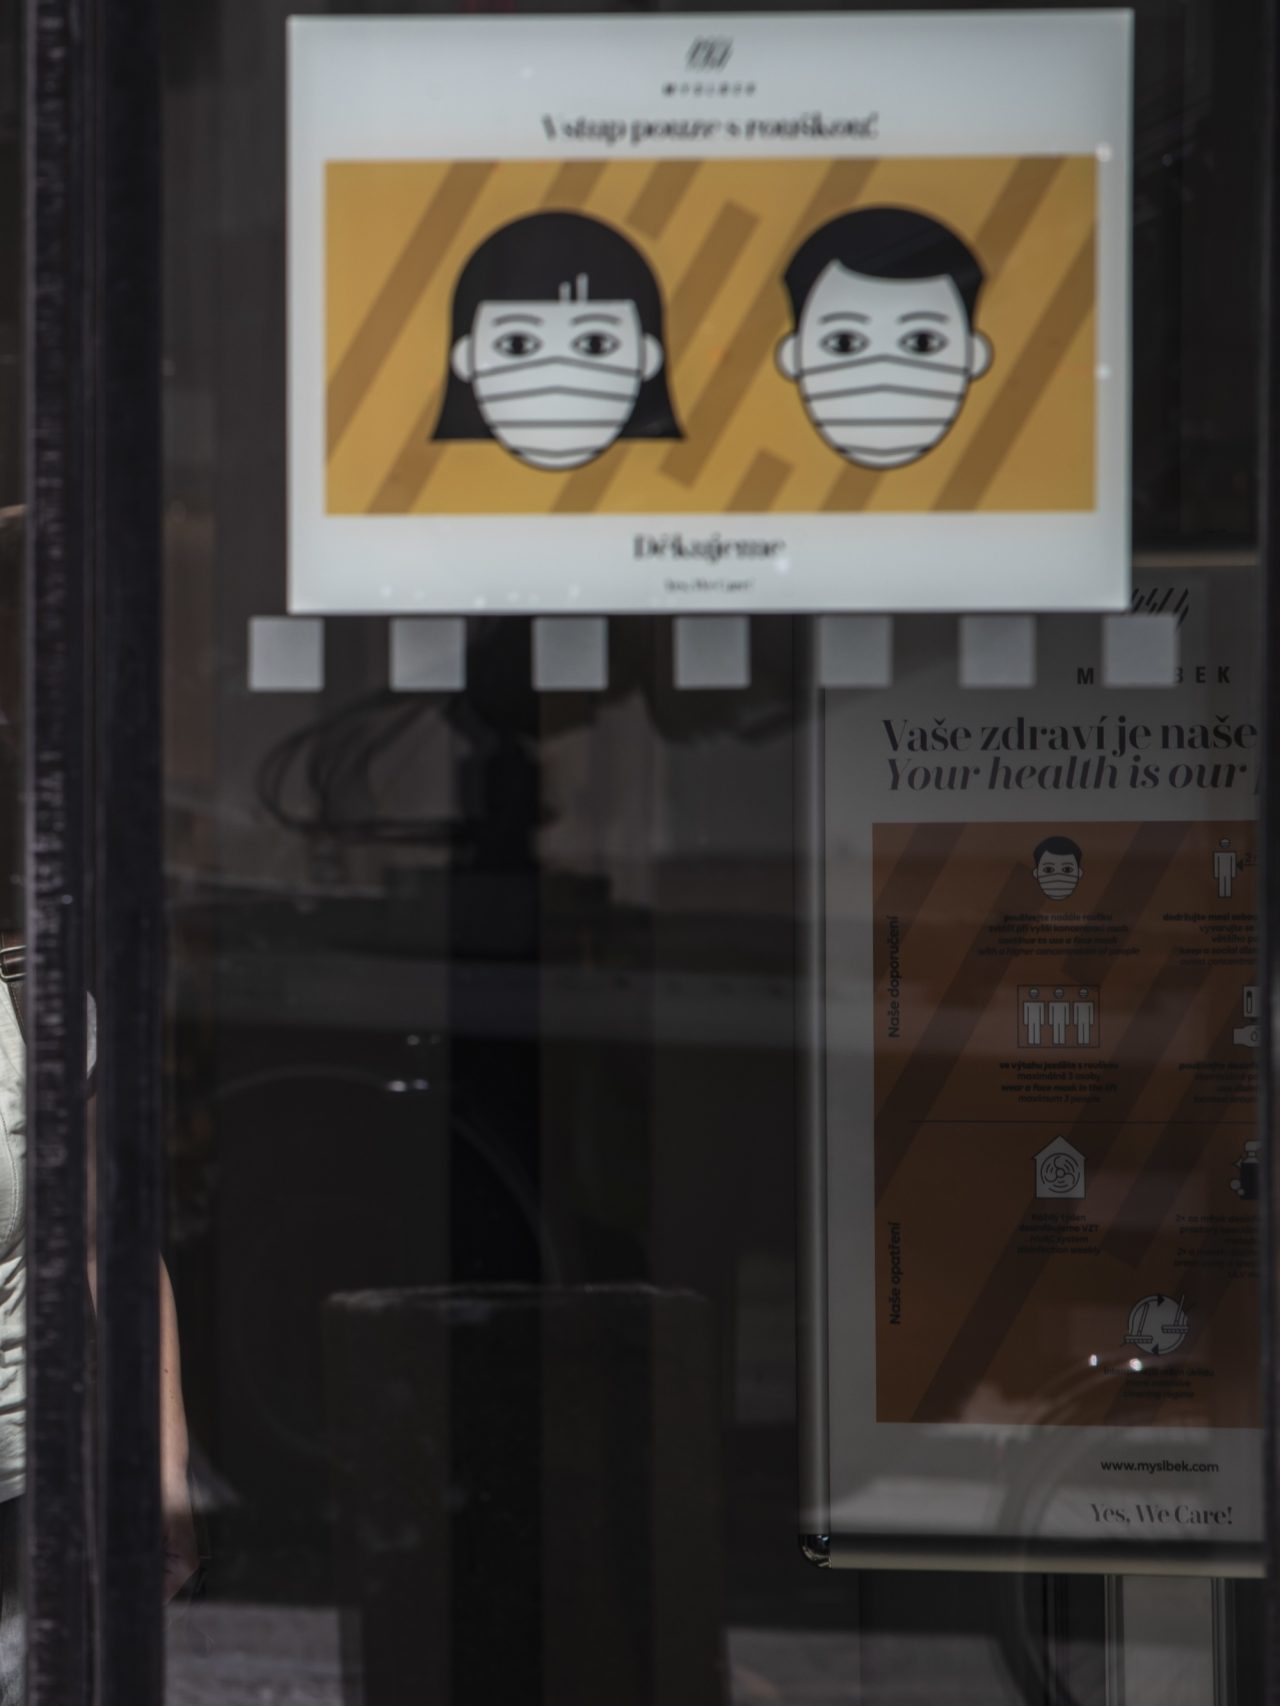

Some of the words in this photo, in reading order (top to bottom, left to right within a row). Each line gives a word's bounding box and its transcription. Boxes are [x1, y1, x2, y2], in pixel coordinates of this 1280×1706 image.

[1077, 666, 1232, 685] MBEK
[882, 717, 972, 752] Vaše
[979, 715, 1108, 751] zdraví
[1112, 715, 1151, 758] je
[1160, 714, 1258, 750] naše
[888, 758, 981, 791] Your
[987, 756, 1118, 790] health
[1129, 754, 1160, 789] is
[1168, 763, 1248, 789] our
[886, 915, 903, 998] doporučení
[888, 1000, 901, 1038] Naše
[888, 1287, 901, 1325] Naše
[1100, 1460, 1220, 1475] www.myslbek.com
[1090, 1503, 1131, 1524] Yes,
[1135, 1504, 1170, 1524] We
[1173, 1504, 1233, 1525] Care!
